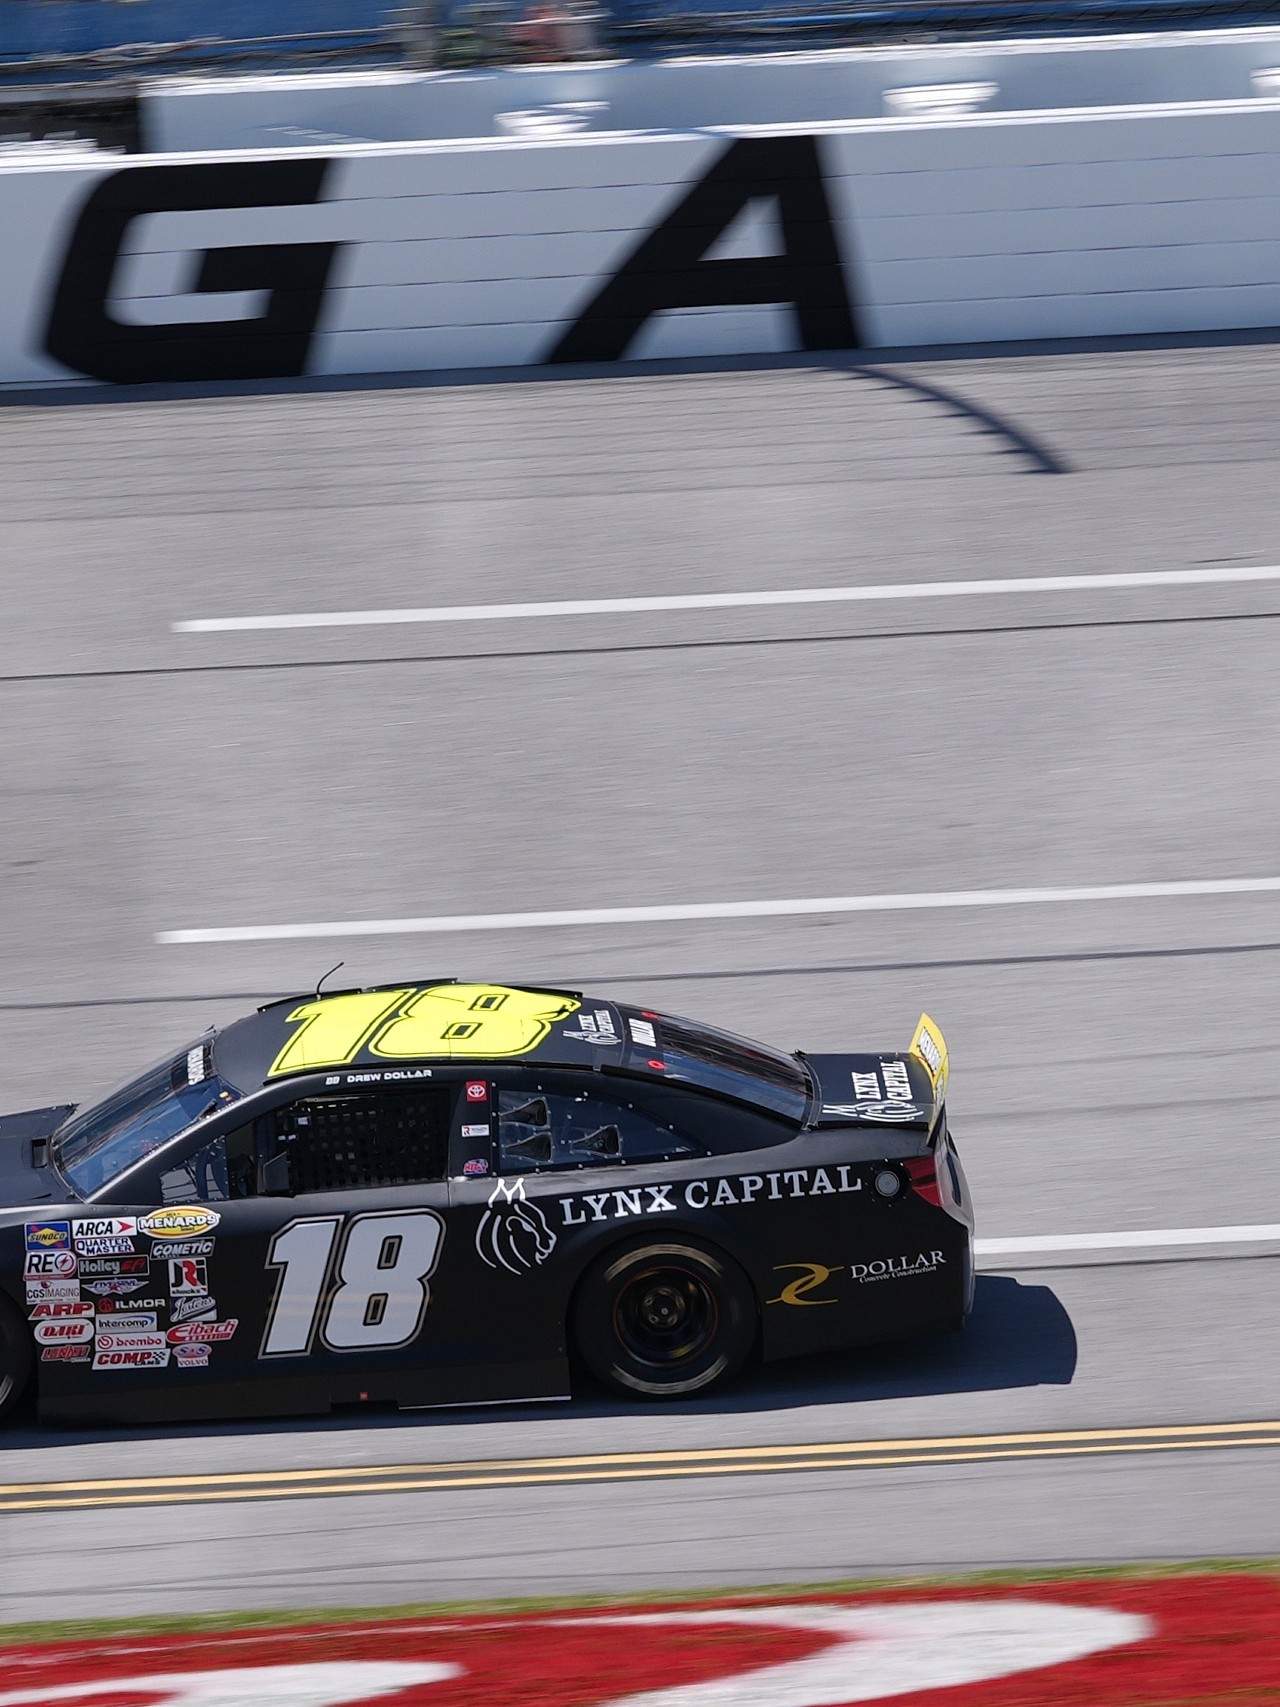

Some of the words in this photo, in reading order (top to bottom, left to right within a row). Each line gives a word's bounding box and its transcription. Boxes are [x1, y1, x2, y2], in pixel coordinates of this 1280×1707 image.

[267, 984, 582, 1077] 18
[347, 1073, 382, 1083] DREW
[384, 1069, 432, 1081] DOLLAR
[880, 1061, 913, 1100] CAPITAL
[852, 1072, 882, 1100] LYNX
[560, 1184, 677, 1226] LYNX
[684, 1165, 862, 1209] CAPITAL
[75, 1221, 113, 1236] ARCA
[140, 1215, 216, 1230] MENARDS
[30, 1233, 67, 1241] SUNOCO
[76, 1238, 128, 1251] QUARTER
[86, 1245, 131, 1255] MASTER
[153, 1241, 213, 1256] COMETIC
[80, 1259, 120, 1274] Holley
[851, 1250, 946, 1279] DOLLAR
[258, 1207, 447, 1360] 18
[31, 1302, 93, 1317] ARP
[115, 1299, 166, 1309] ILMOR
[99, 1319, 149, 1328] Intercomp
[167, 1320, 237, 1342] Eibach
[116, 1336, 162, 1347] brembo
[97, 1351, 153, 1365] COMP
[179, 1358, 208, 1366] VOLVO
